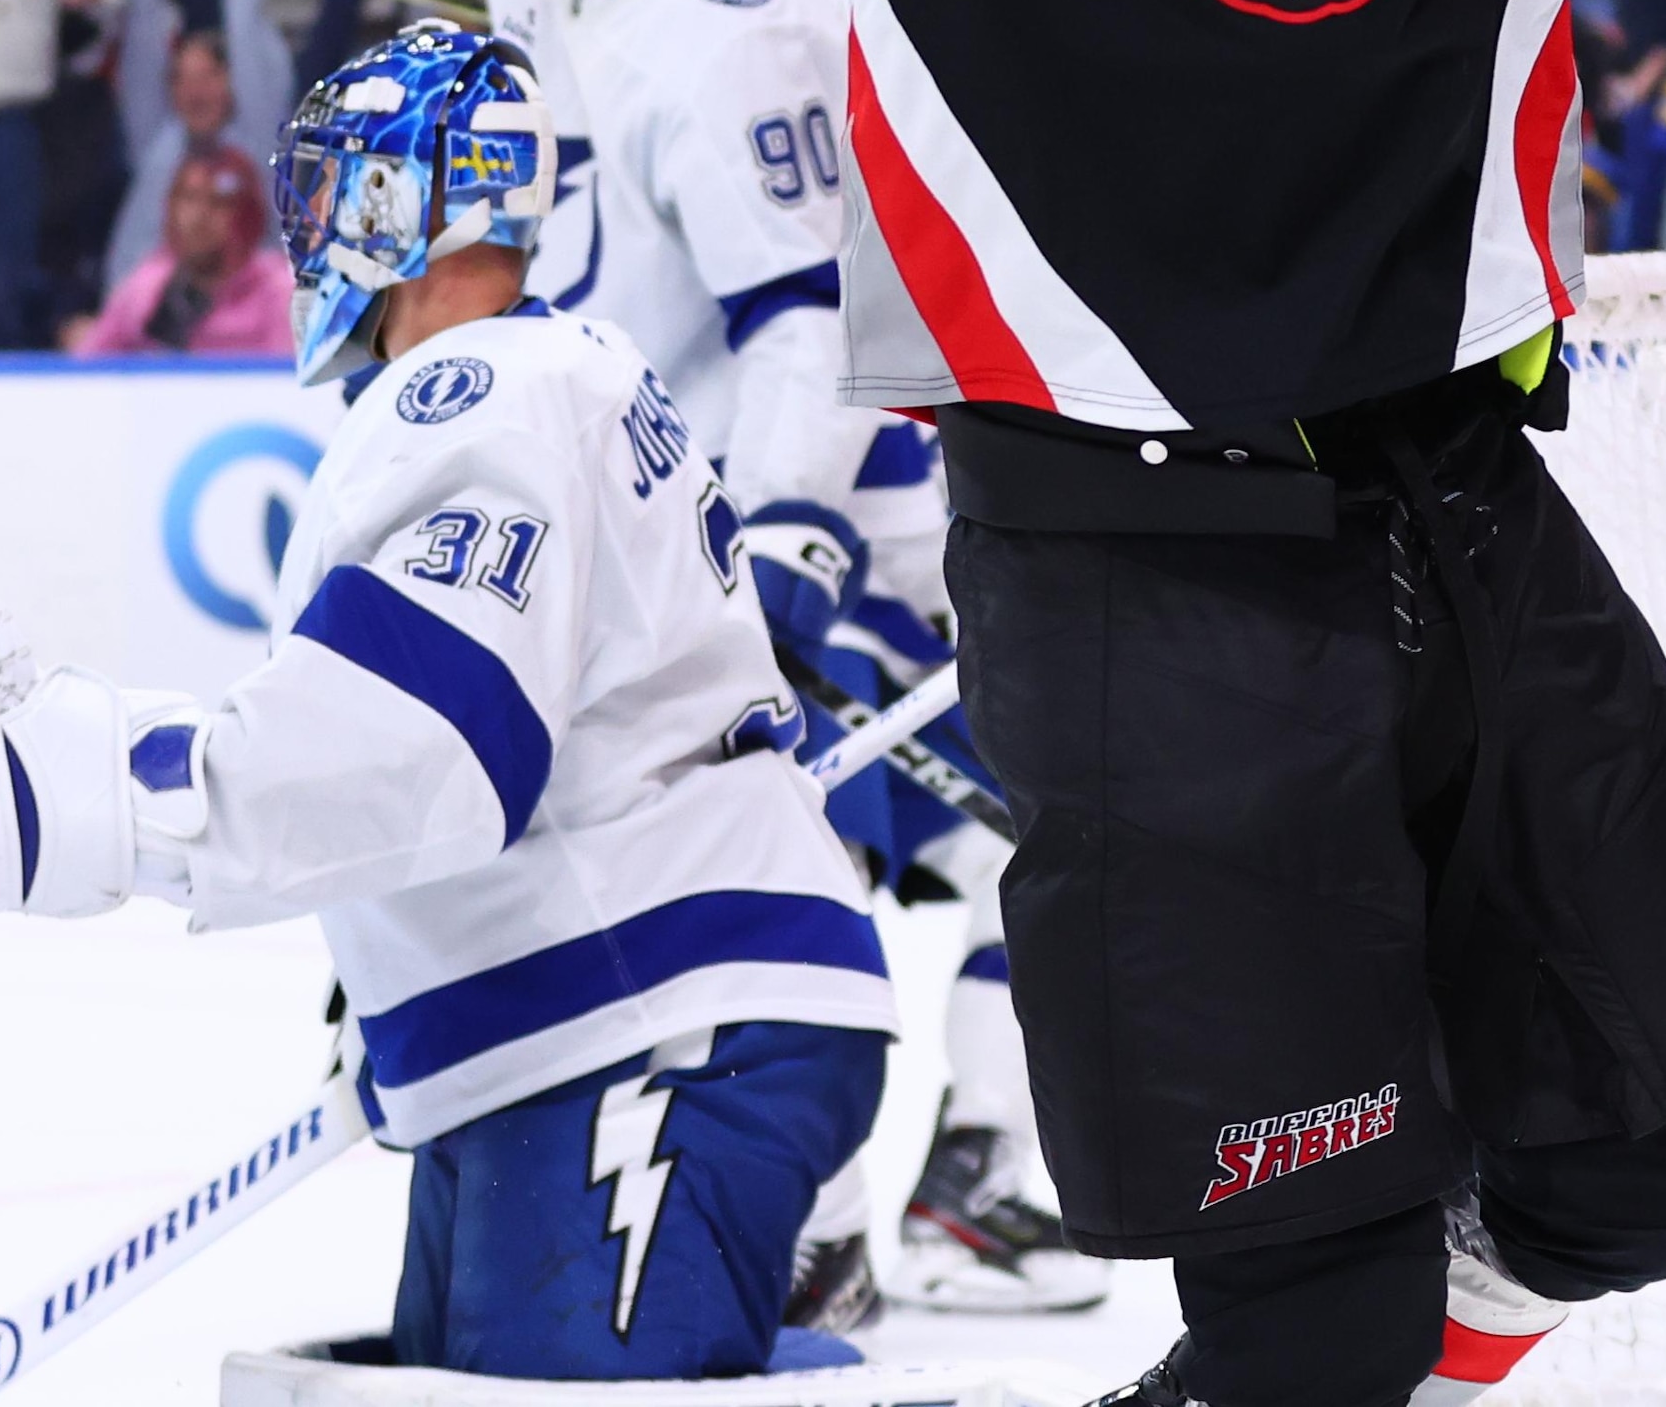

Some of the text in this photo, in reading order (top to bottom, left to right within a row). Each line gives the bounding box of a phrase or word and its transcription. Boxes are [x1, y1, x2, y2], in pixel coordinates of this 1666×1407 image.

[746, 96, 841, 210] 90
[404, 506, 550, 614] 31
[1198, 1102, 1396, 1212] SABRES
[1215, 1082, 1398, 1150] BUFFALO
[40, 1104, 324, 1334] WARRIOR
